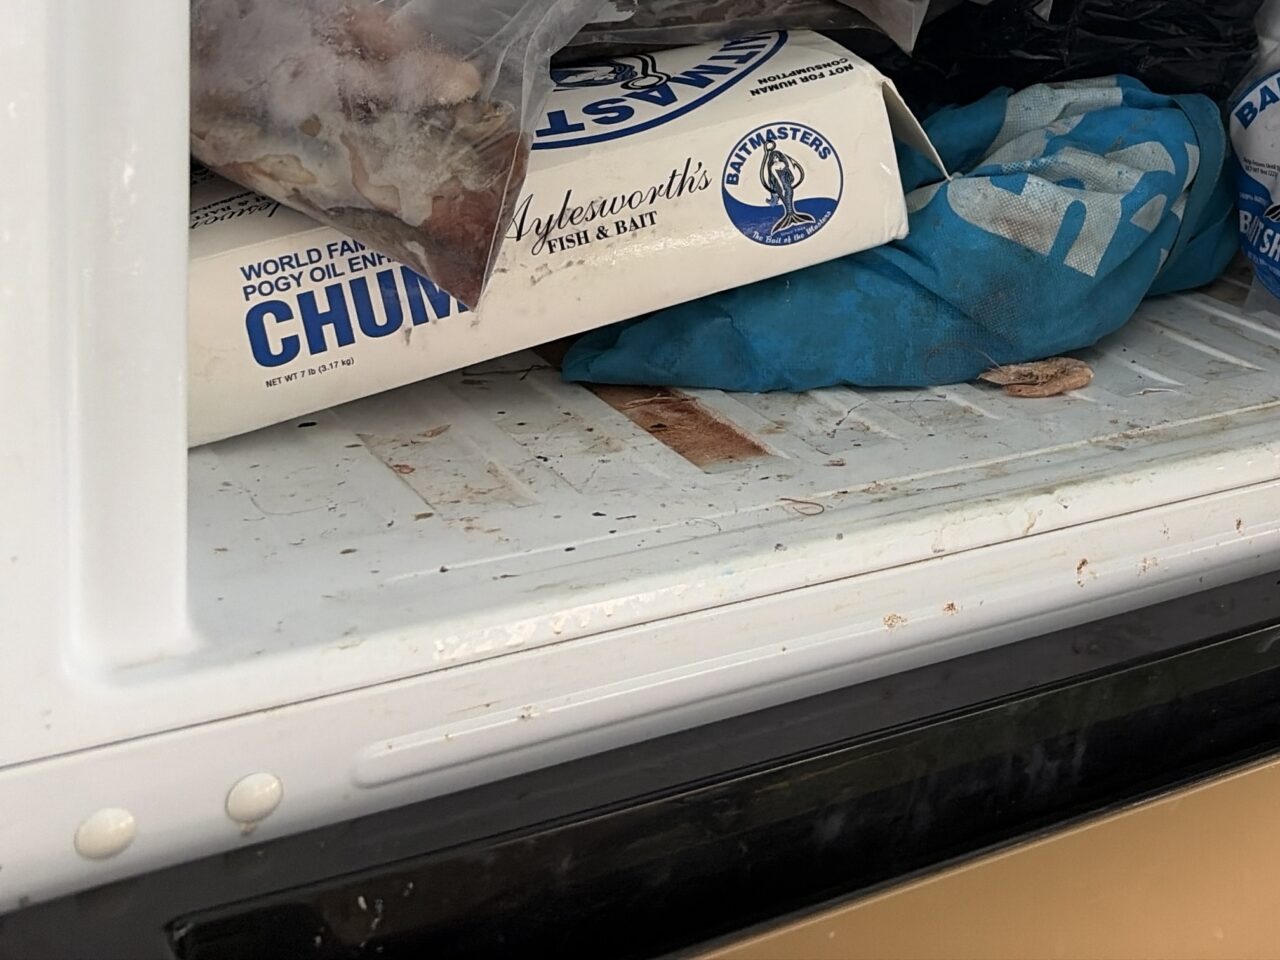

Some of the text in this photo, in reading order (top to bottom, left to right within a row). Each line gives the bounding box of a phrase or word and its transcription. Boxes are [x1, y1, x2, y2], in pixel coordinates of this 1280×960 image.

[750, 63, 854, 96] NOT FOR HUMAN
[757, 58, 849, 84] CONSUMPTION
[728, 126, 833, 186] BAITMASTERS
[504, 157, 713, 256] Aylesworth's
[546, 211, 658, 255] FISH & BAIT
[240, 248, 322, 281] WORLD
[243, 271, 304, 301] POGY
[309, 262, 346, 282] OIL
[265, 357, 355, 388] NET WT 7 lb (3.17 kg)
